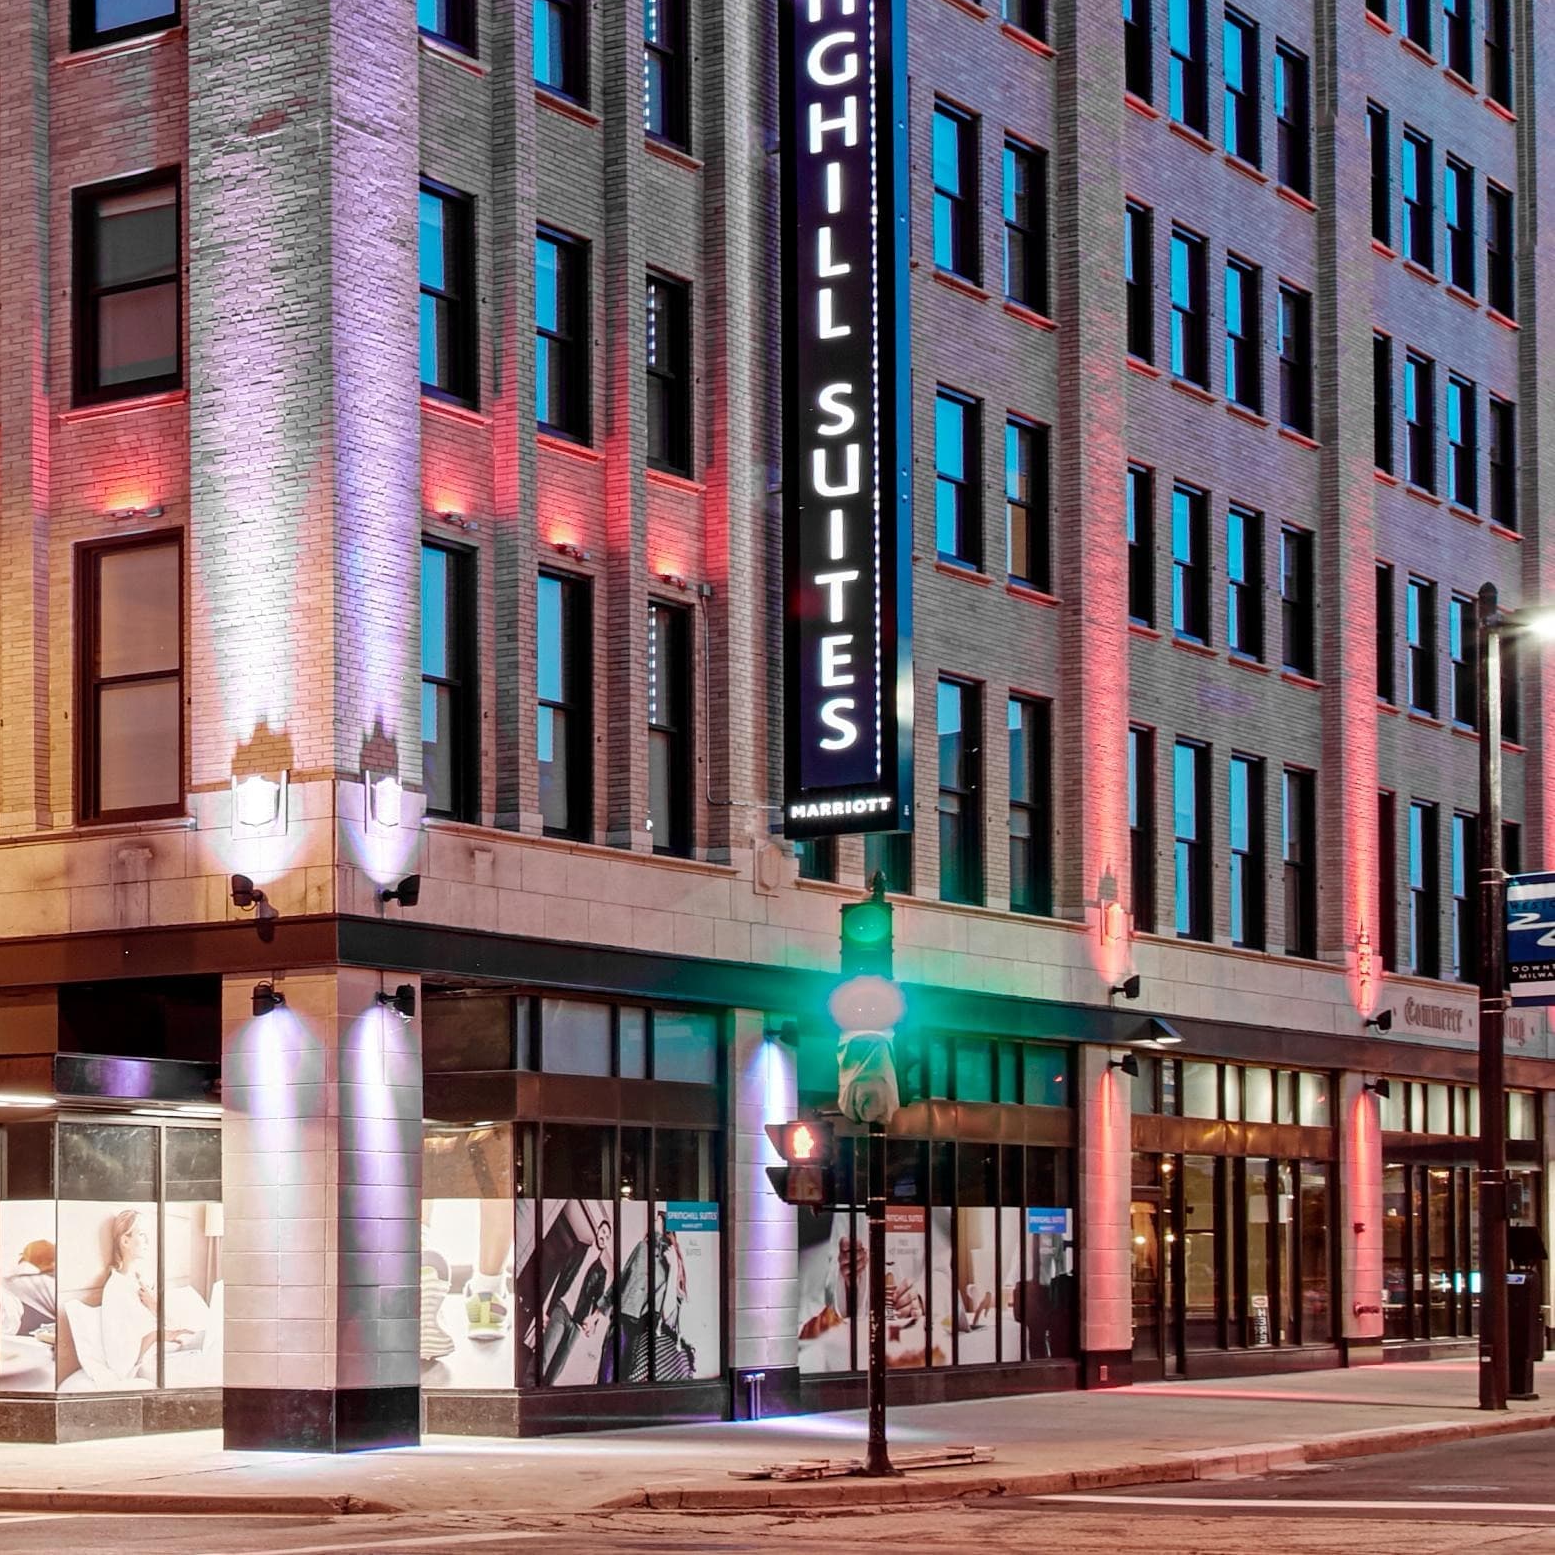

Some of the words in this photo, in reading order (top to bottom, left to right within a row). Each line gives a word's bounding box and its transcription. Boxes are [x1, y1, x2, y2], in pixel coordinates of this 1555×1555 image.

[812, 382, 861, 751] SUITES
[790, 796, 891, 819] MARRIOTT
[1404, 996, 1463, 1033] Commerce
